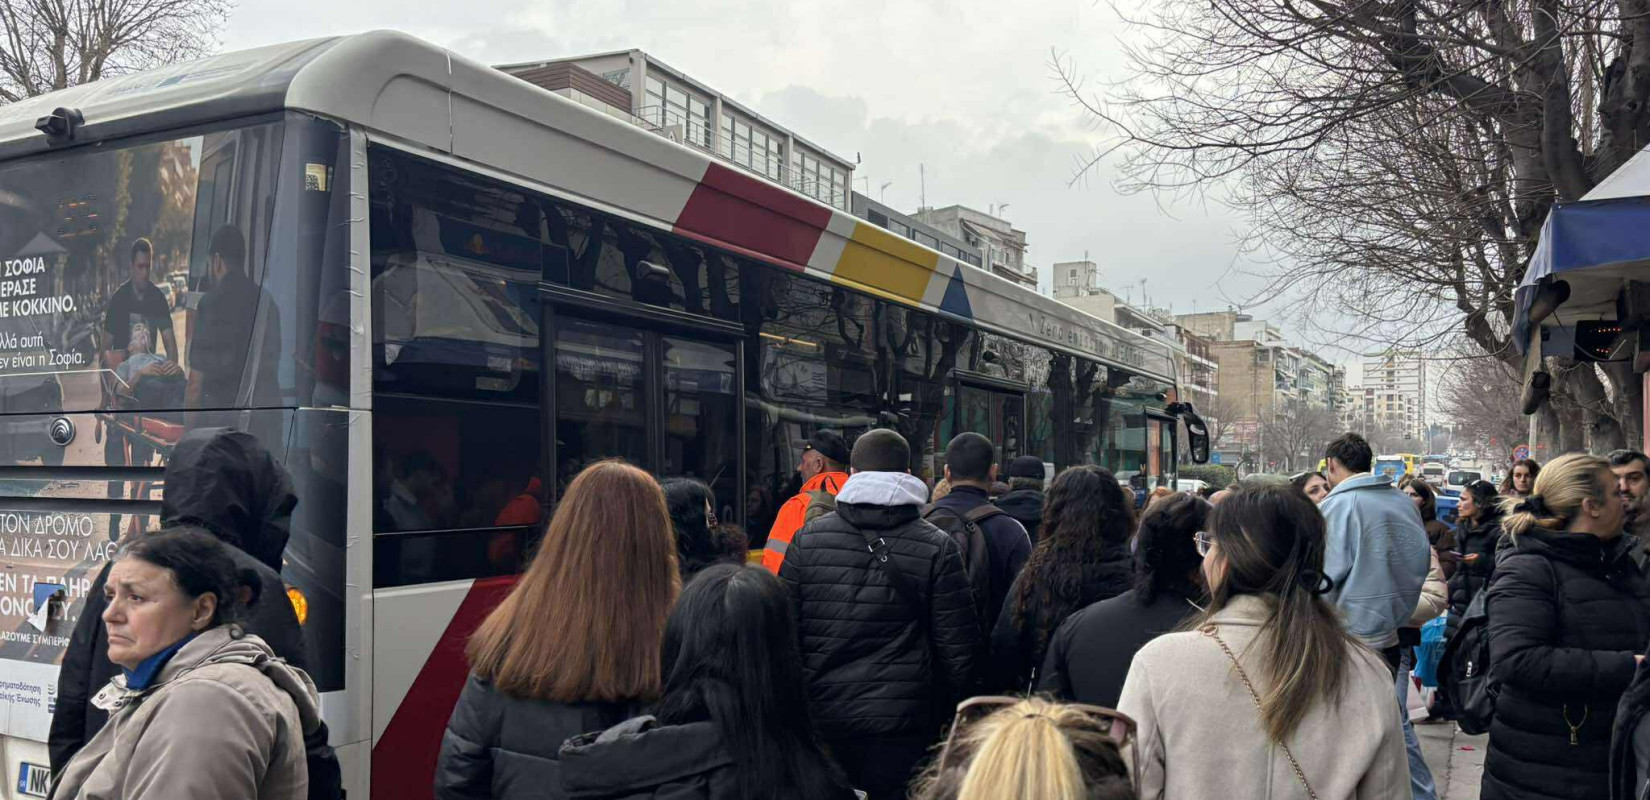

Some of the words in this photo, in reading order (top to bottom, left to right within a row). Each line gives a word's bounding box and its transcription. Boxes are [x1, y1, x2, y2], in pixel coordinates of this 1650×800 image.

[5, 257, 45, 276] ΣΟΦΙΑ
[13, 295, 77, 316] ΚΟΚΚΙΝΟ.
[1040, 316, 1063, 339] Zero
[20, 331, 44, 347] αυτή
[12, 352, 35, 367] είναι
[39, 355, 45, 366] η
[49, 348, 86, 370] Σοφία.
[35, 515, 93, 536] ΔΡΟΜΟ
[11, 538, 43, 558] ΔΙΚΑ
[47, 539, 79, 560] ΣΟΥ
[46, 576, 94, 598] ΛΗΡ
[0, 630, 31, 643] ΑΖΟΥΜΕ
[30, 767, 50, 793] NK
